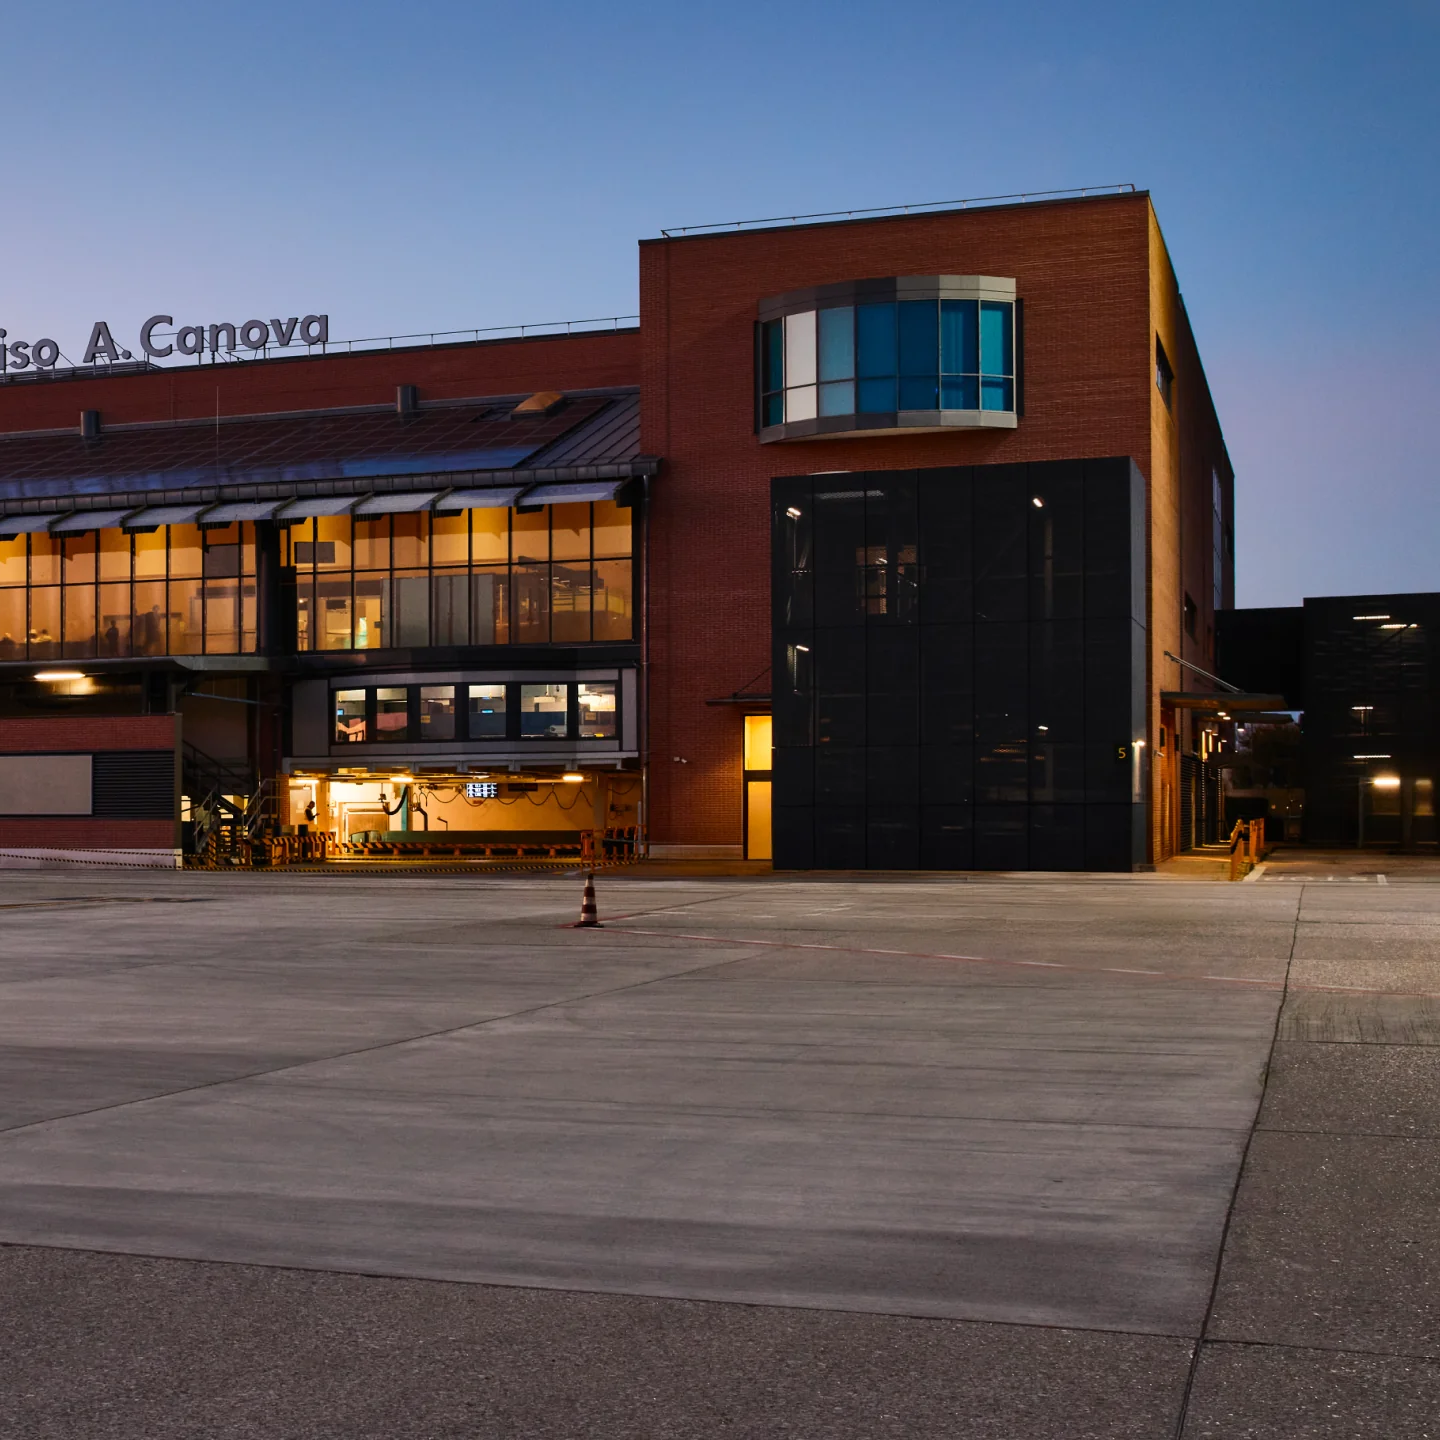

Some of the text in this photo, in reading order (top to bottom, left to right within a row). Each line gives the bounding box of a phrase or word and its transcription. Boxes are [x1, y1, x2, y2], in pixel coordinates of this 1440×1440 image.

[82, 321, 132, 364] A.
[140, 314, 329, 358] Canova
[1118, 747, 1127, 759] 5
